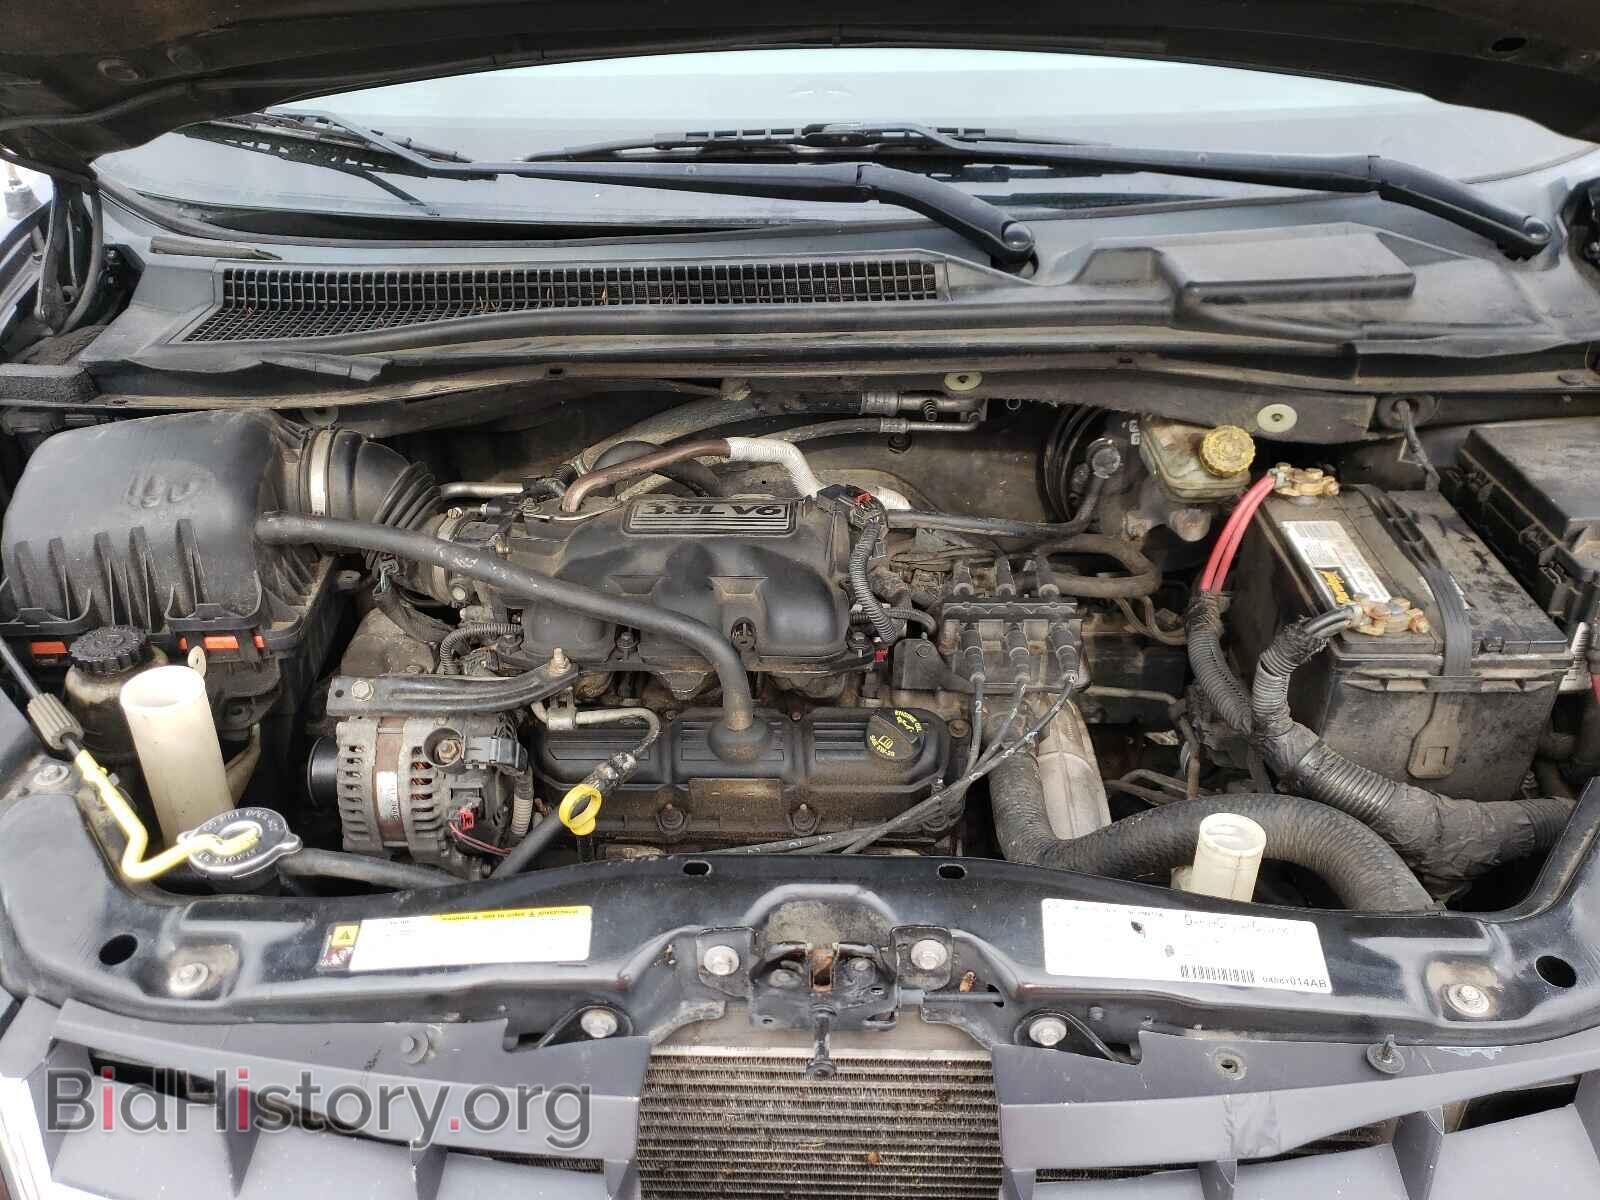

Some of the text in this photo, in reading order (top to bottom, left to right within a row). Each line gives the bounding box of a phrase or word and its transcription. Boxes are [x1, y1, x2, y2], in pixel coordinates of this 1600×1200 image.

[645, 503, 782, 515] 3.8L V6
[975, 700, 982, 713] 2
[895, 709, 923, 733] ENGINE OIL
[869, 734, 879, 747] SAE
